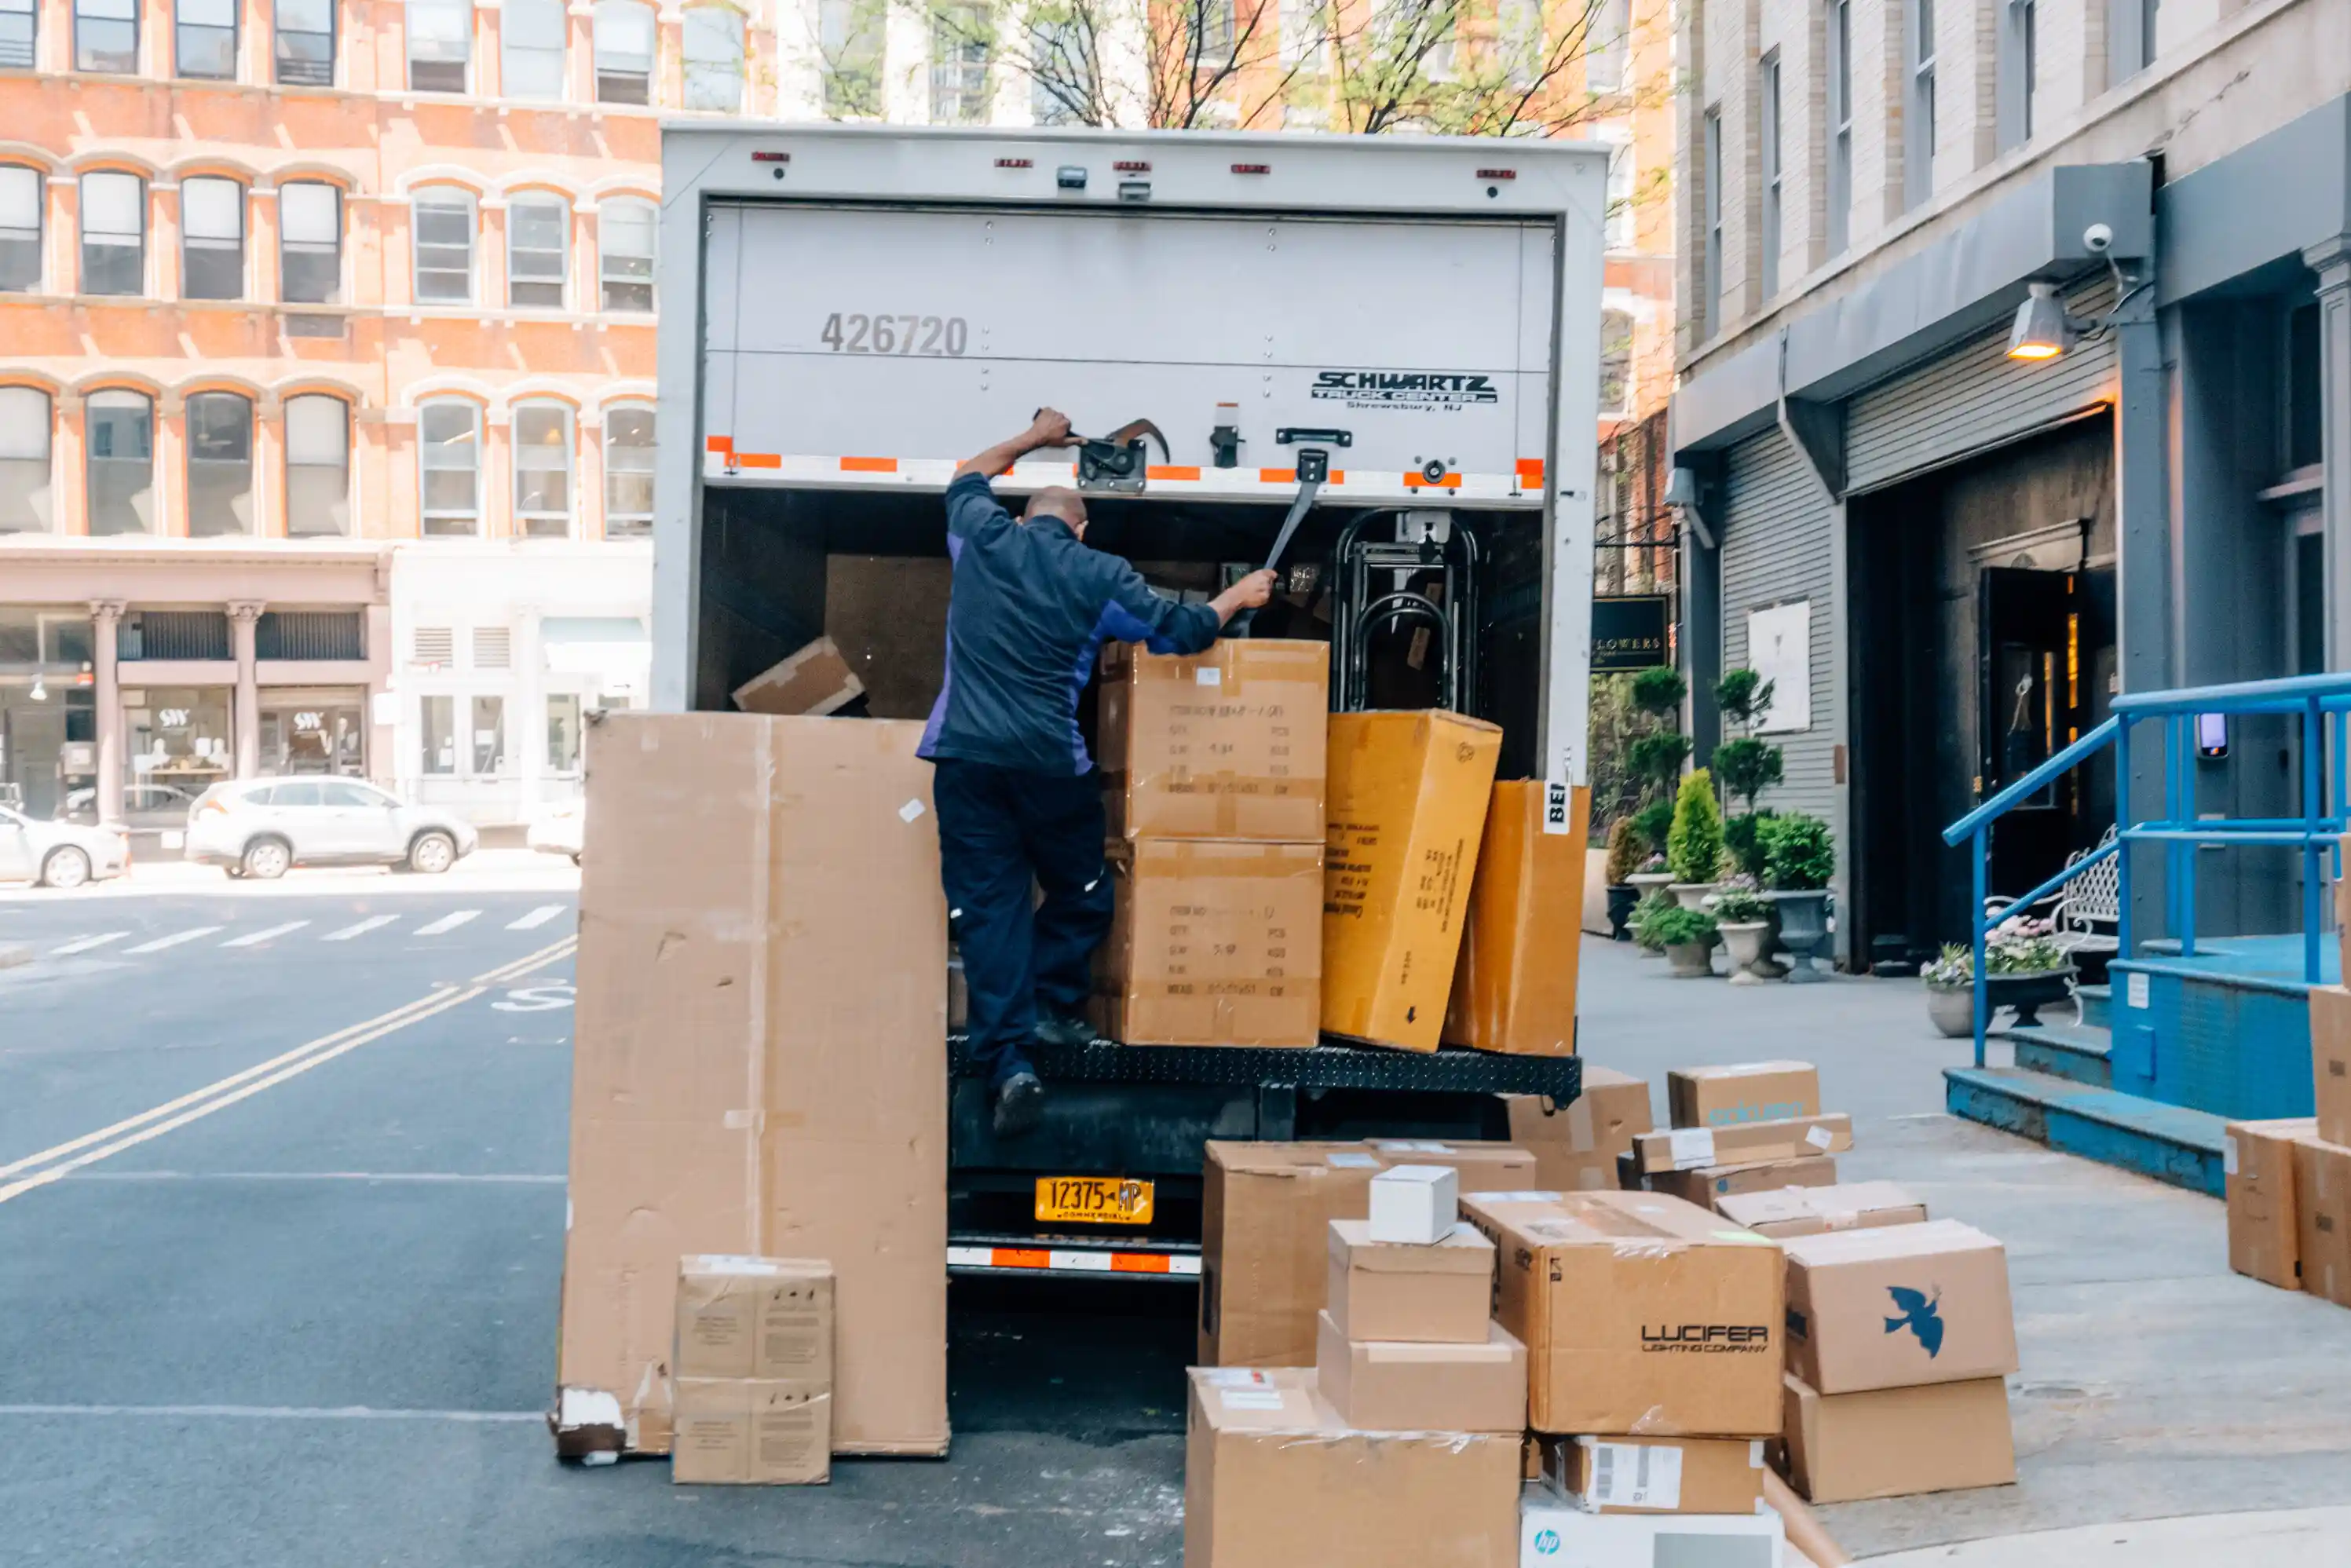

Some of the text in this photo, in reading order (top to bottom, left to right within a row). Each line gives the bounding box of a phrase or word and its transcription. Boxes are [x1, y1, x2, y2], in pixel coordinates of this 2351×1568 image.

[821, 313, 968, 356] 426720
[1312, 371, 1497, 393] SCHWARTZ
[1312, 389, 1478, 403] TRUCK CENTER
[1346, 400, 1436, 412] Shrewsbury,
[1051, 1180, 1106, 1210] 12375
[1641, 1325, 1768, 1343] LUCIFER
[1641, 1343, 1768, 1354] LIGHTING COMPANY
[1535, 1530, 1559, 1555] hp
